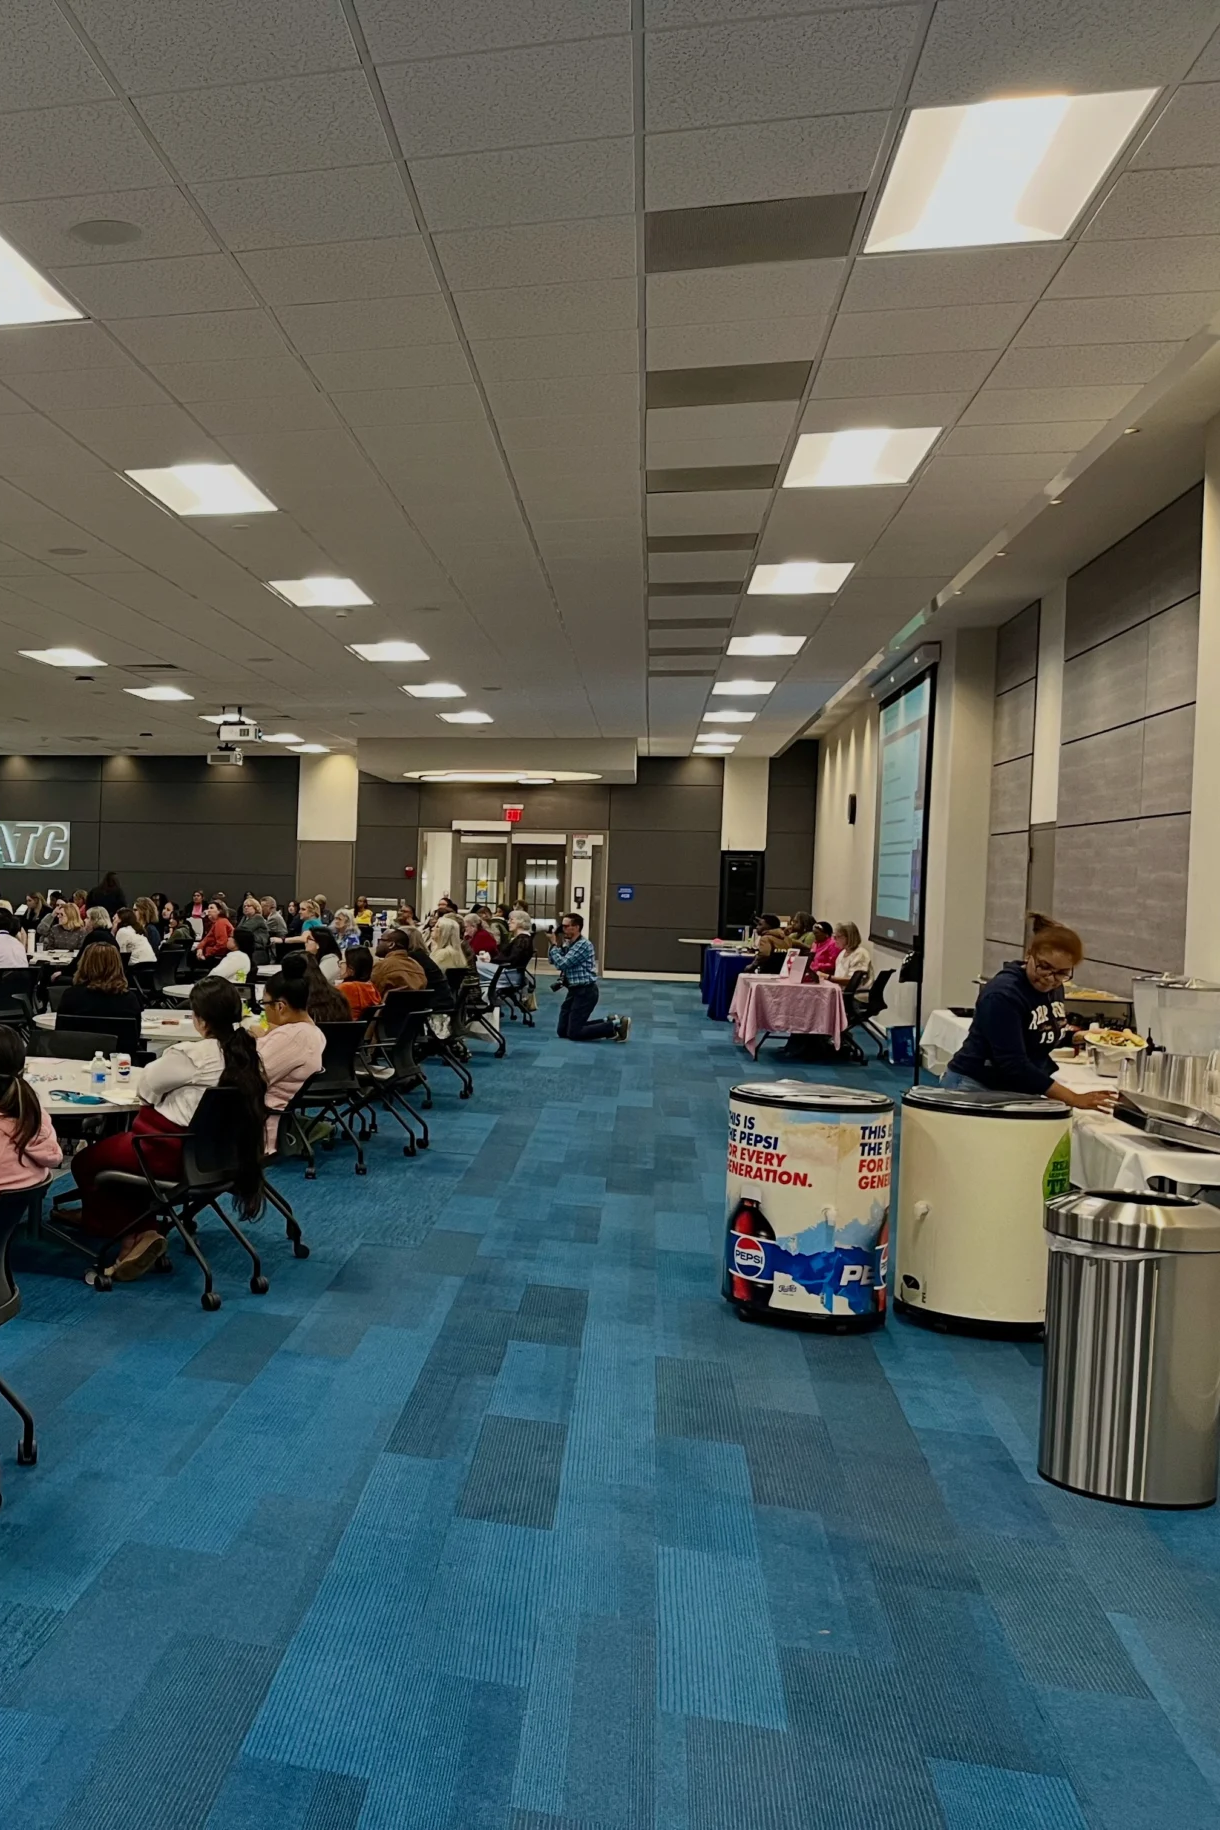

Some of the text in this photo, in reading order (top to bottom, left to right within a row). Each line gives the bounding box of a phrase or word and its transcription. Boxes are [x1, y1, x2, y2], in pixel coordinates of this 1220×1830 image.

[729, 1110, 756, 1131] HIS IS
[729, 1126, 779, 1151] HE PEPSI
[860, 1124, 887, 1140] THIS
[740, 1147, 787, 1168] EVERY
[859, 1141, 883, 1156] THE
[728, 1158, 813, 1188] ENERATION.
[858, 1158, 884, 1173] FOR
[735, 1249, 764, 1265] PEPSI
